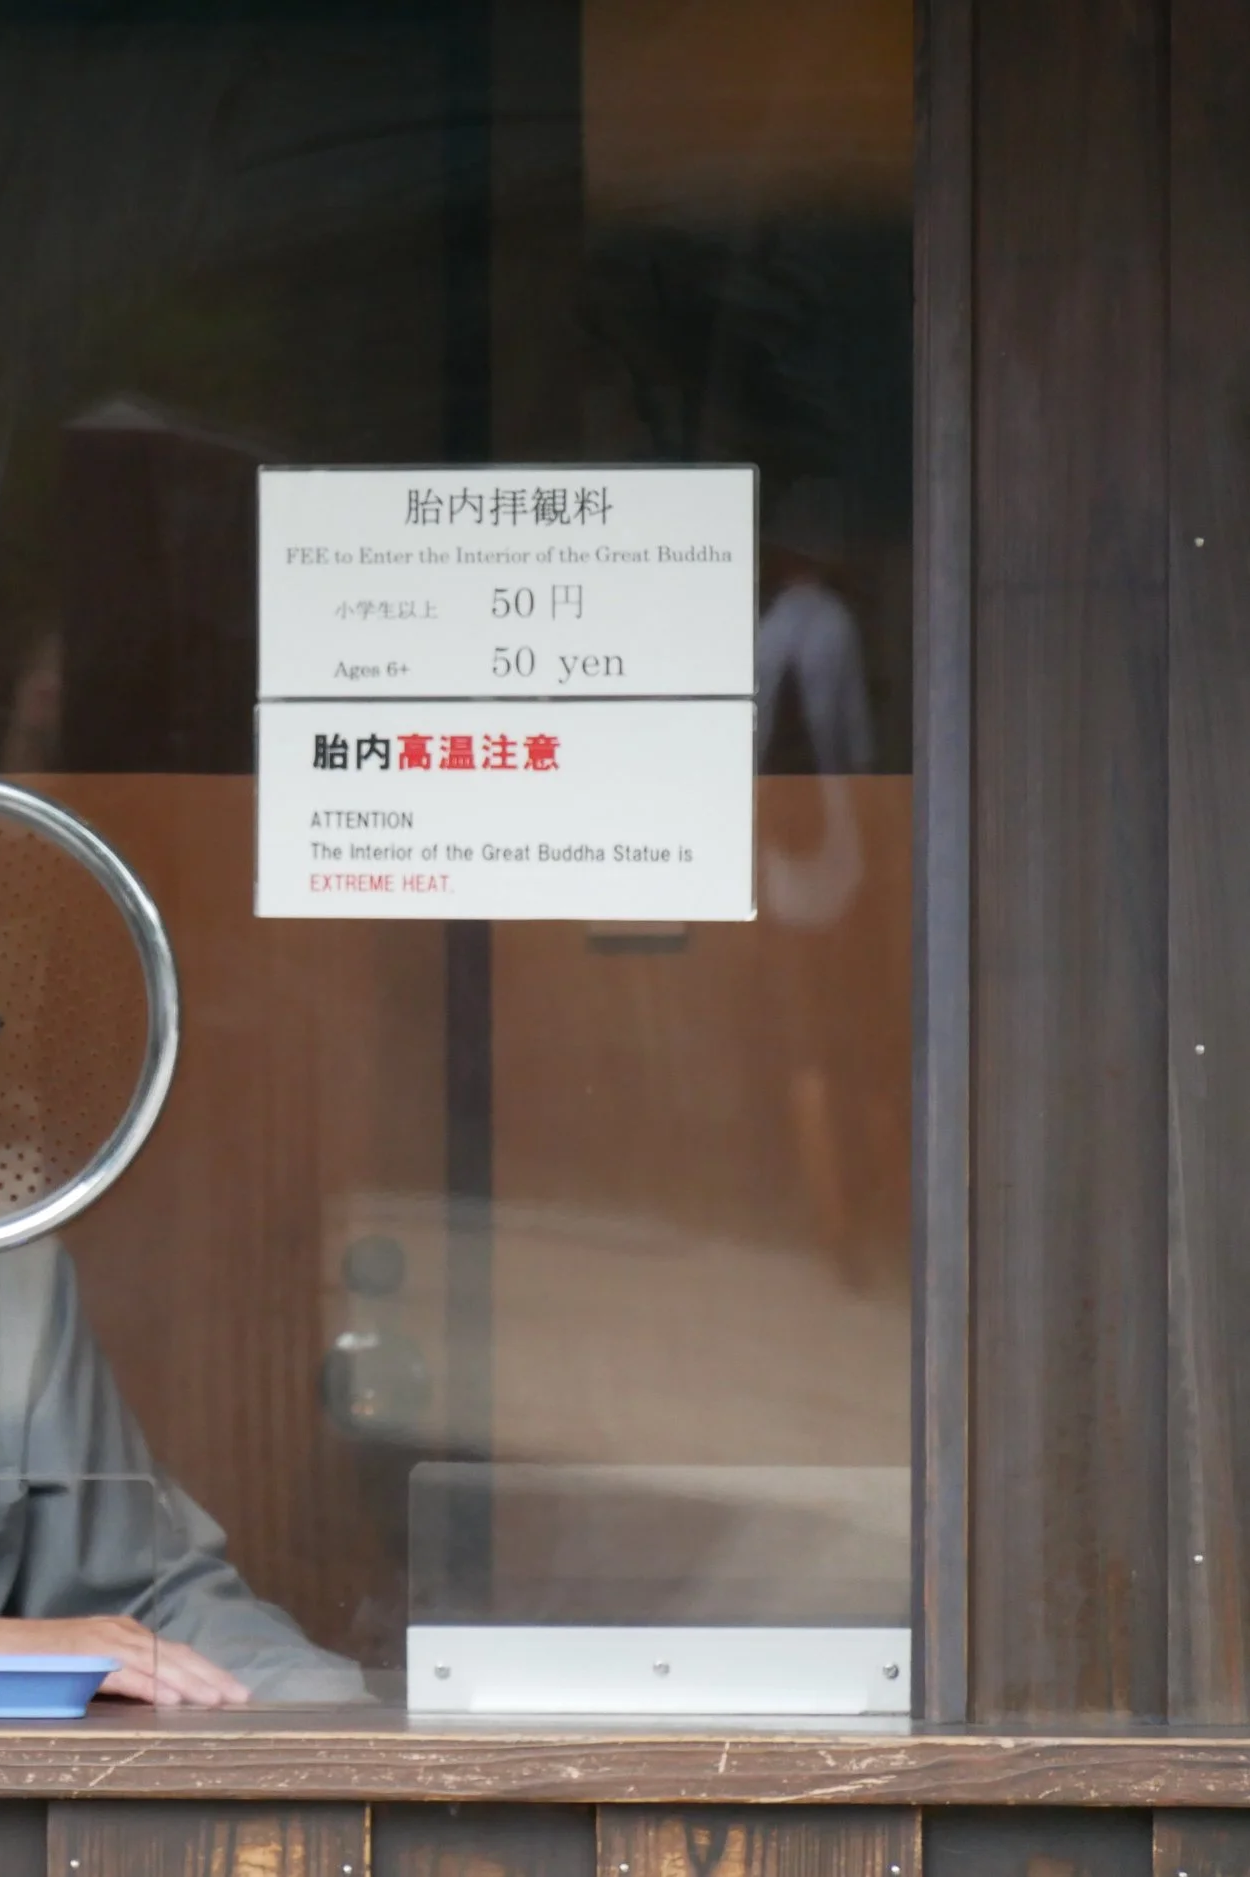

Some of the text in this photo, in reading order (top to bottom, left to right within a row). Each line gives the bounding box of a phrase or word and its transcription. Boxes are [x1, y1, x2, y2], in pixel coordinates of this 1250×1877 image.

[405, 486, 614, 527] 胎内拝観料
[287, 545, 731, 564] FEE to Enter the Interior of the Great Buddha
[334, 600, 439, 620] 小学生以上
[491, 587, 535, 618] 50
[334, 646, 624, 684] Ages 6+ 50 yen
[312, 732, 561, 772] 胎内高温注意
[311, 810, 413, 829] ATTENTION
[311, 841, 693, 862] The Interior of the Great Buddha Statue is
[310, 873, 393, 892] EXTREME
